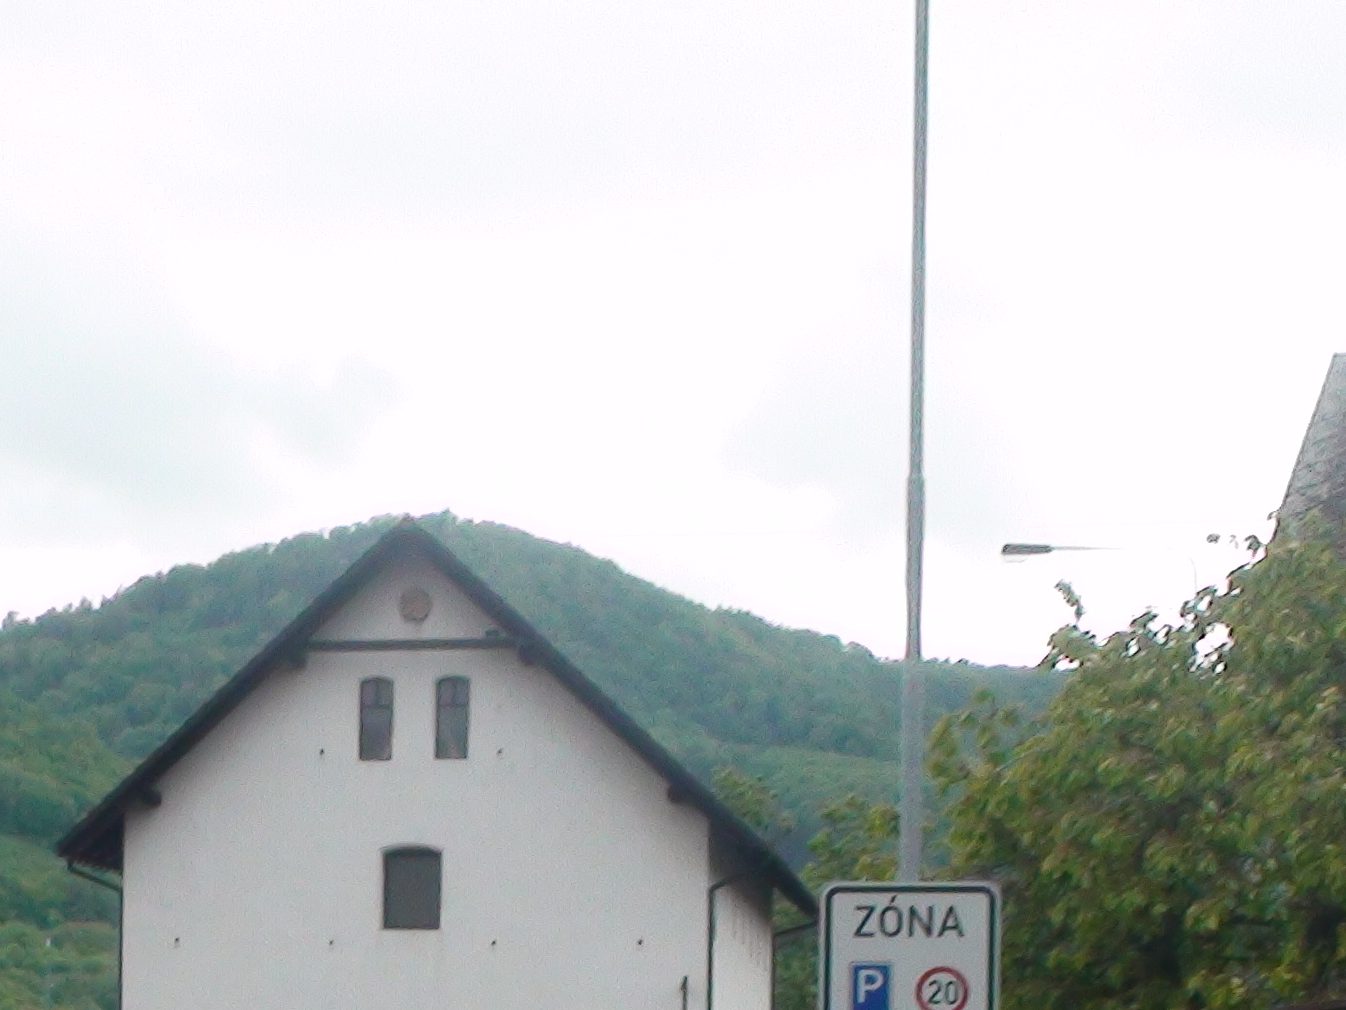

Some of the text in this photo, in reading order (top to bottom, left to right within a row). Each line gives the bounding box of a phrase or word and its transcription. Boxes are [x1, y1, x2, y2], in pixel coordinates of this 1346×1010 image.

[854, 895, 964, 937] ZÓNA
[857, 969, 884, 1003] P
[927, 980, 960, 1005] 20
